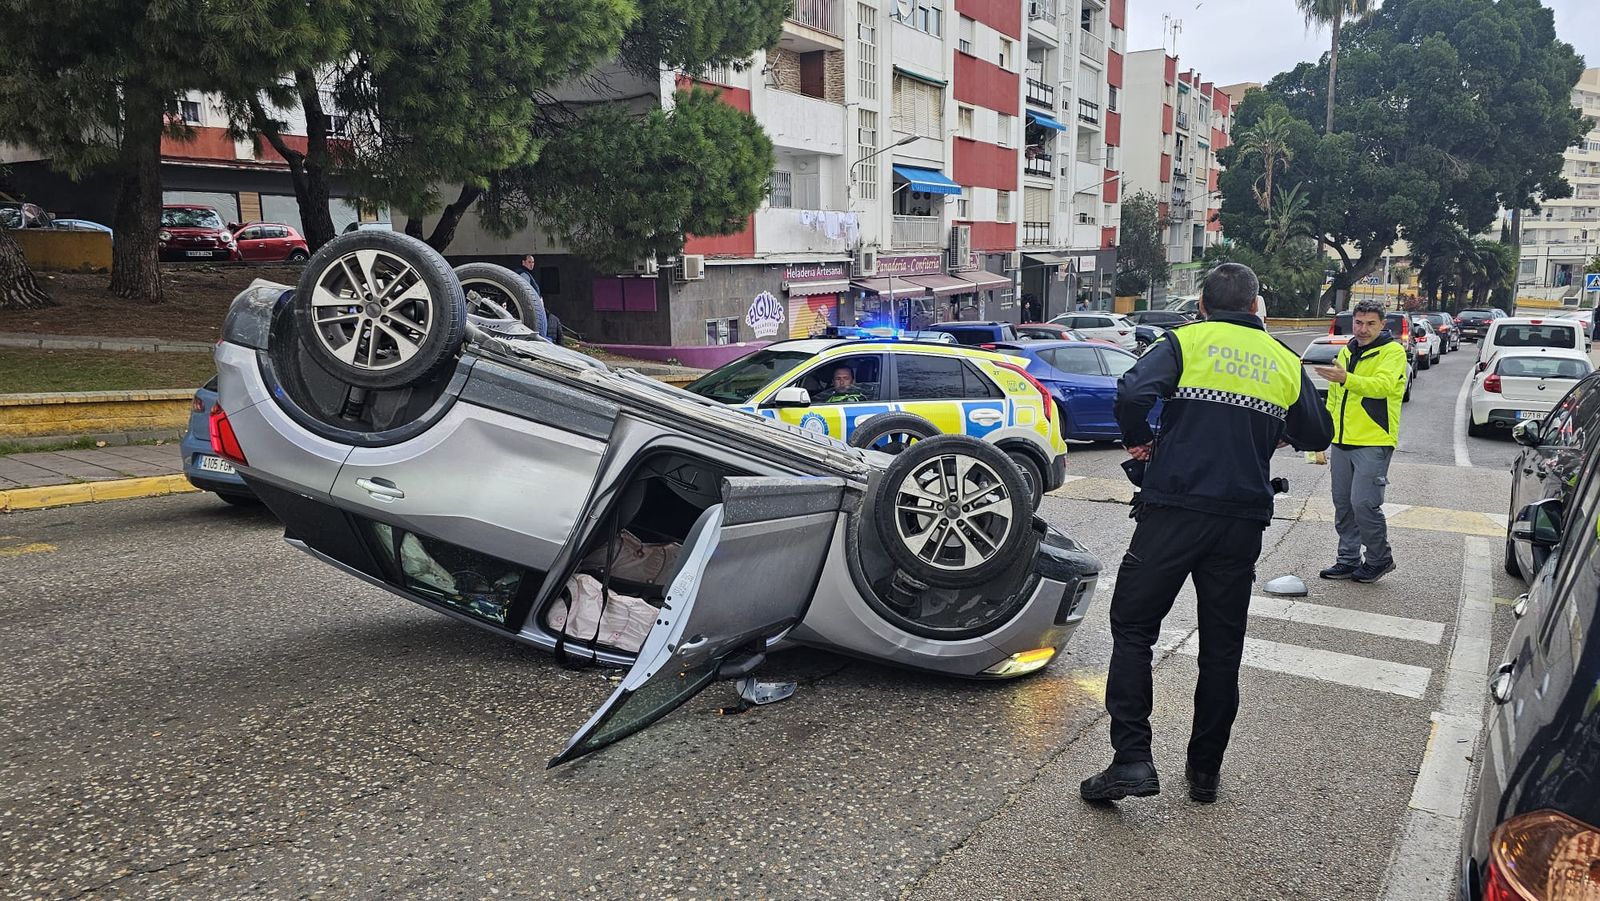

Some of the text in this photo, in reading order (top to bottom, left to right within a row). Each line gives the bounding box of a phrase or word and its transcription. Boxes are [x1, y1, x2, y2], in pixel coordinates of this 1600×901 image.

[816, 264, 843, 276] Artesanal
[1208, 345, 1278, 372] POLICIA
[1214, 360, 1271, 385] LOCAL
[203, 456, 218, 470] 4105
